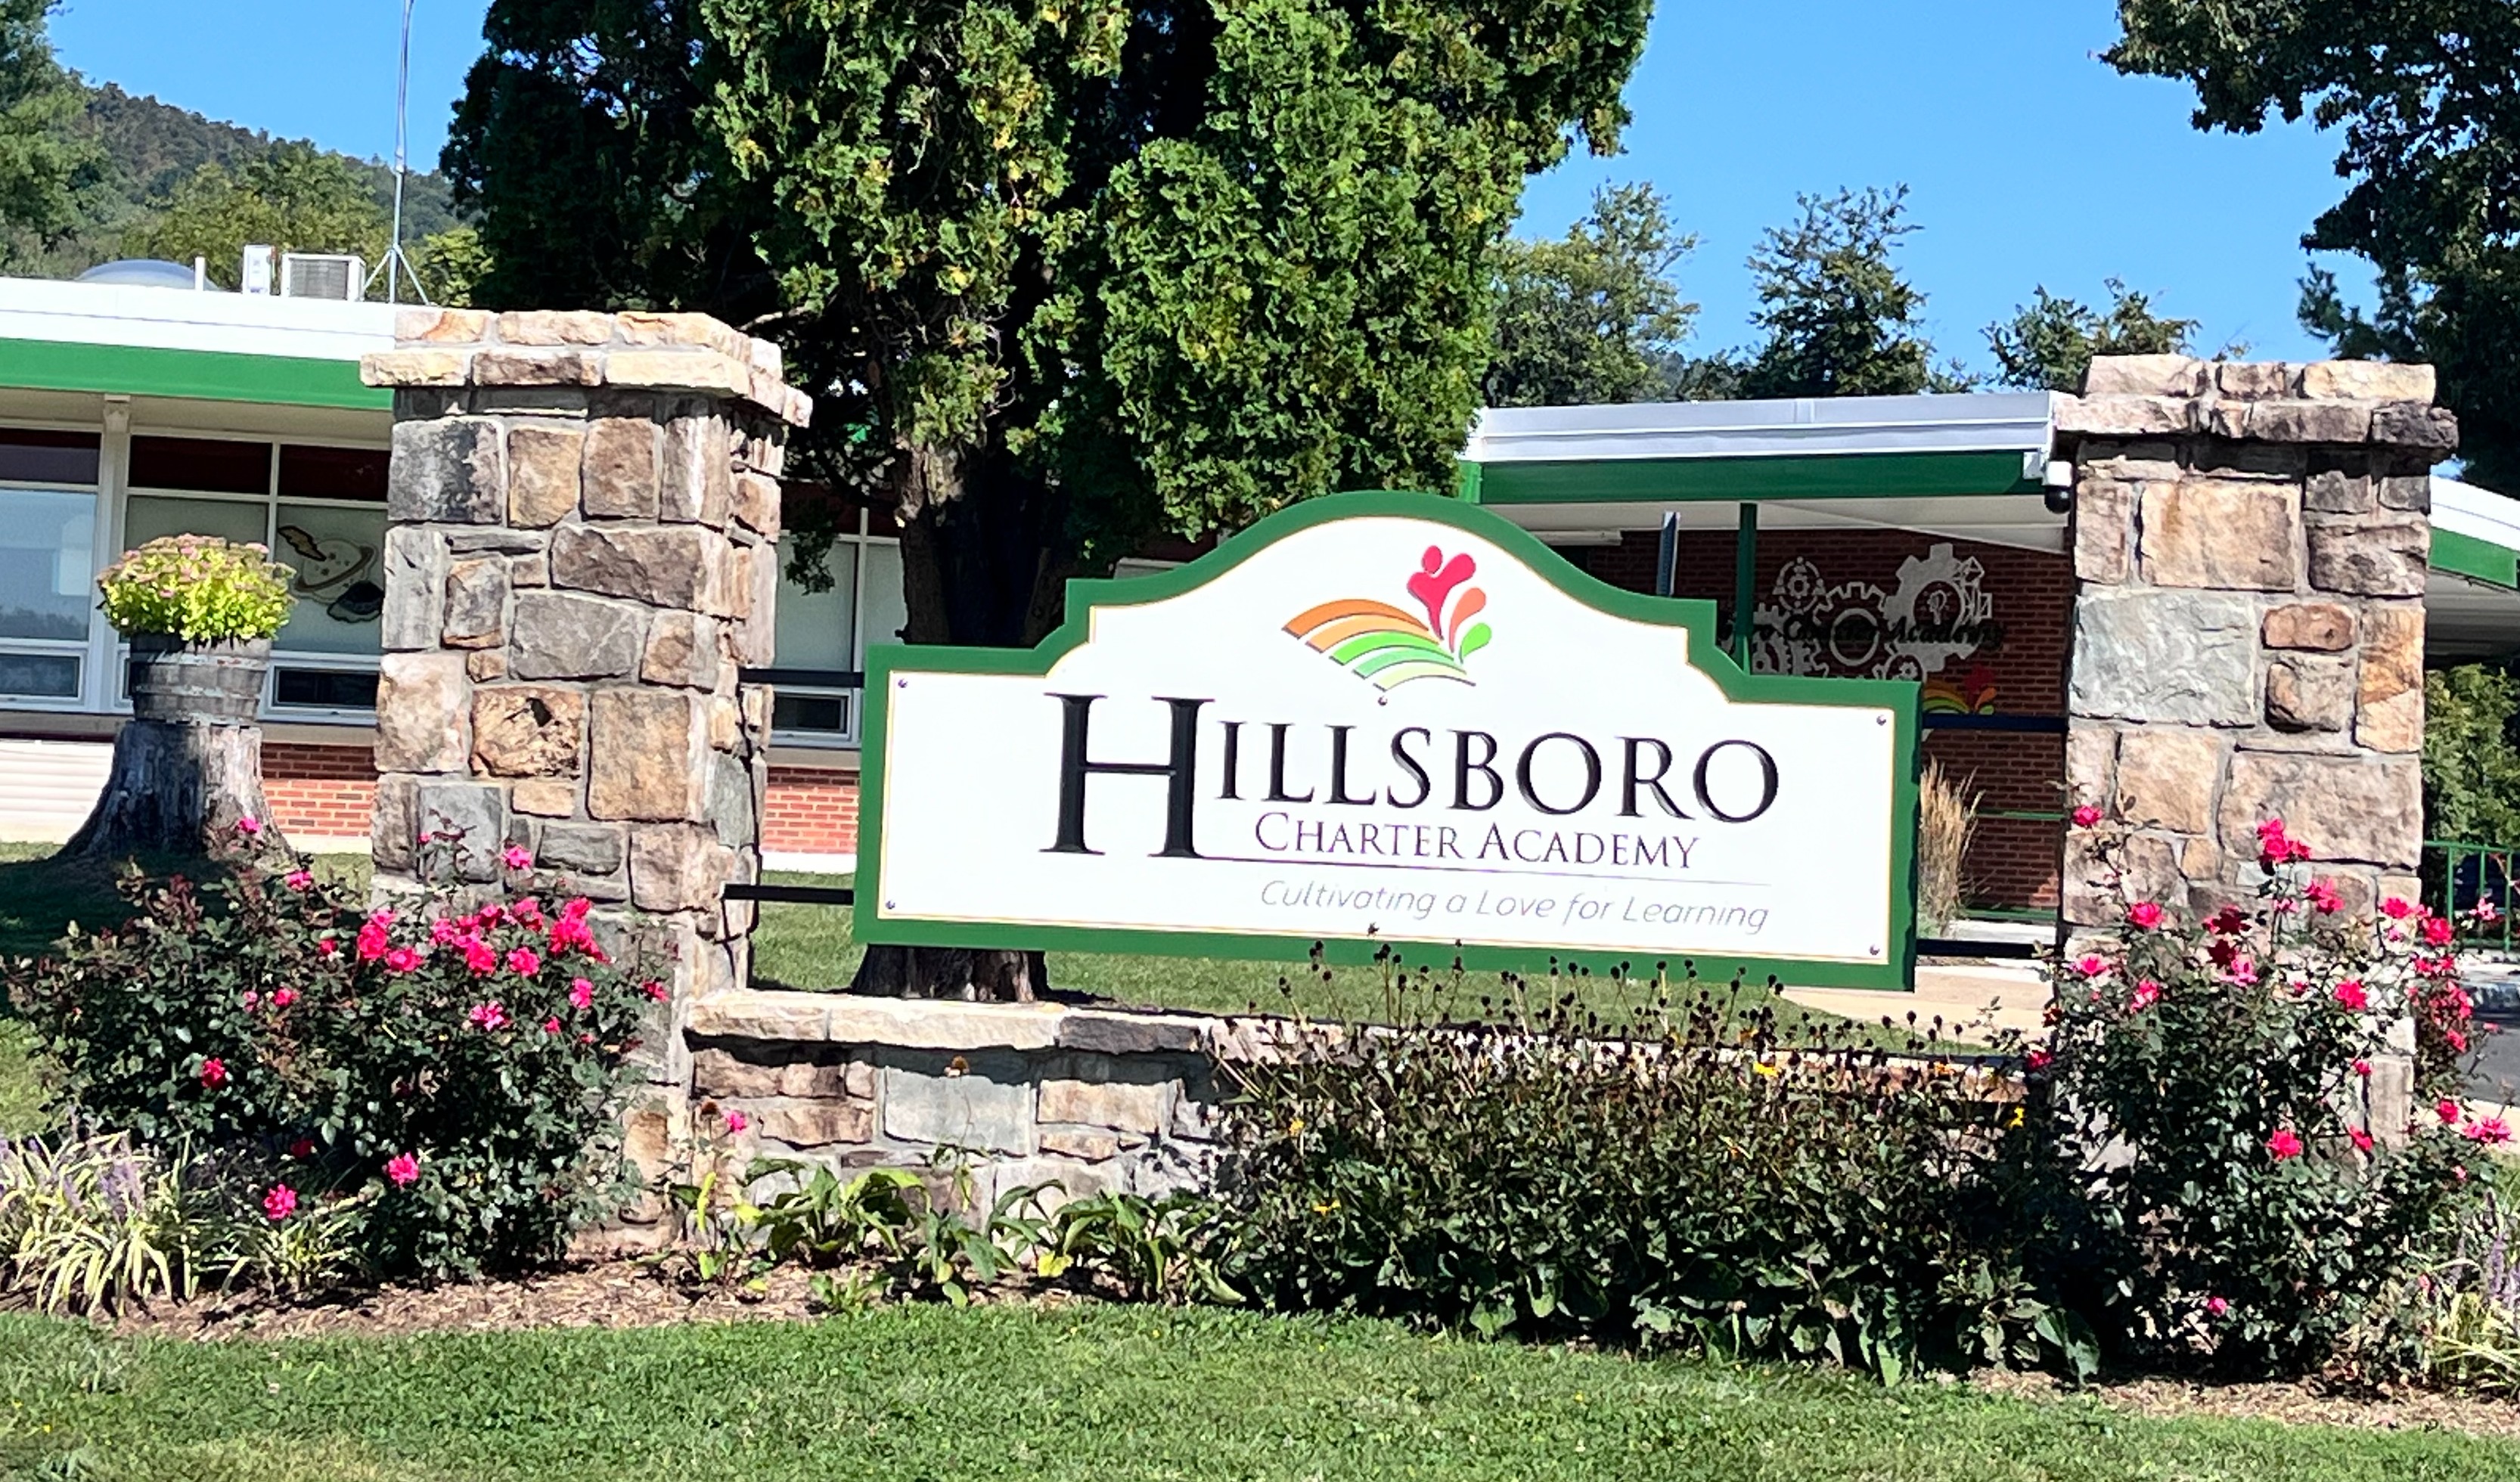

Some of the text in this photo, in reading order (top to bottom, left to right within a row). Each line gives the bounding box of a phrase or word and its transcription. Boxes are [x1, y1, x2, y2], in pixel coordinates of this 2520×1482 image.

[1038, 693, 1779, 859] HILLSBORO
[1255, 811, 1700, 869] CHARTER ACADEMY
[1261, 879, 1770, 935] Cultivating a Love for Learning
